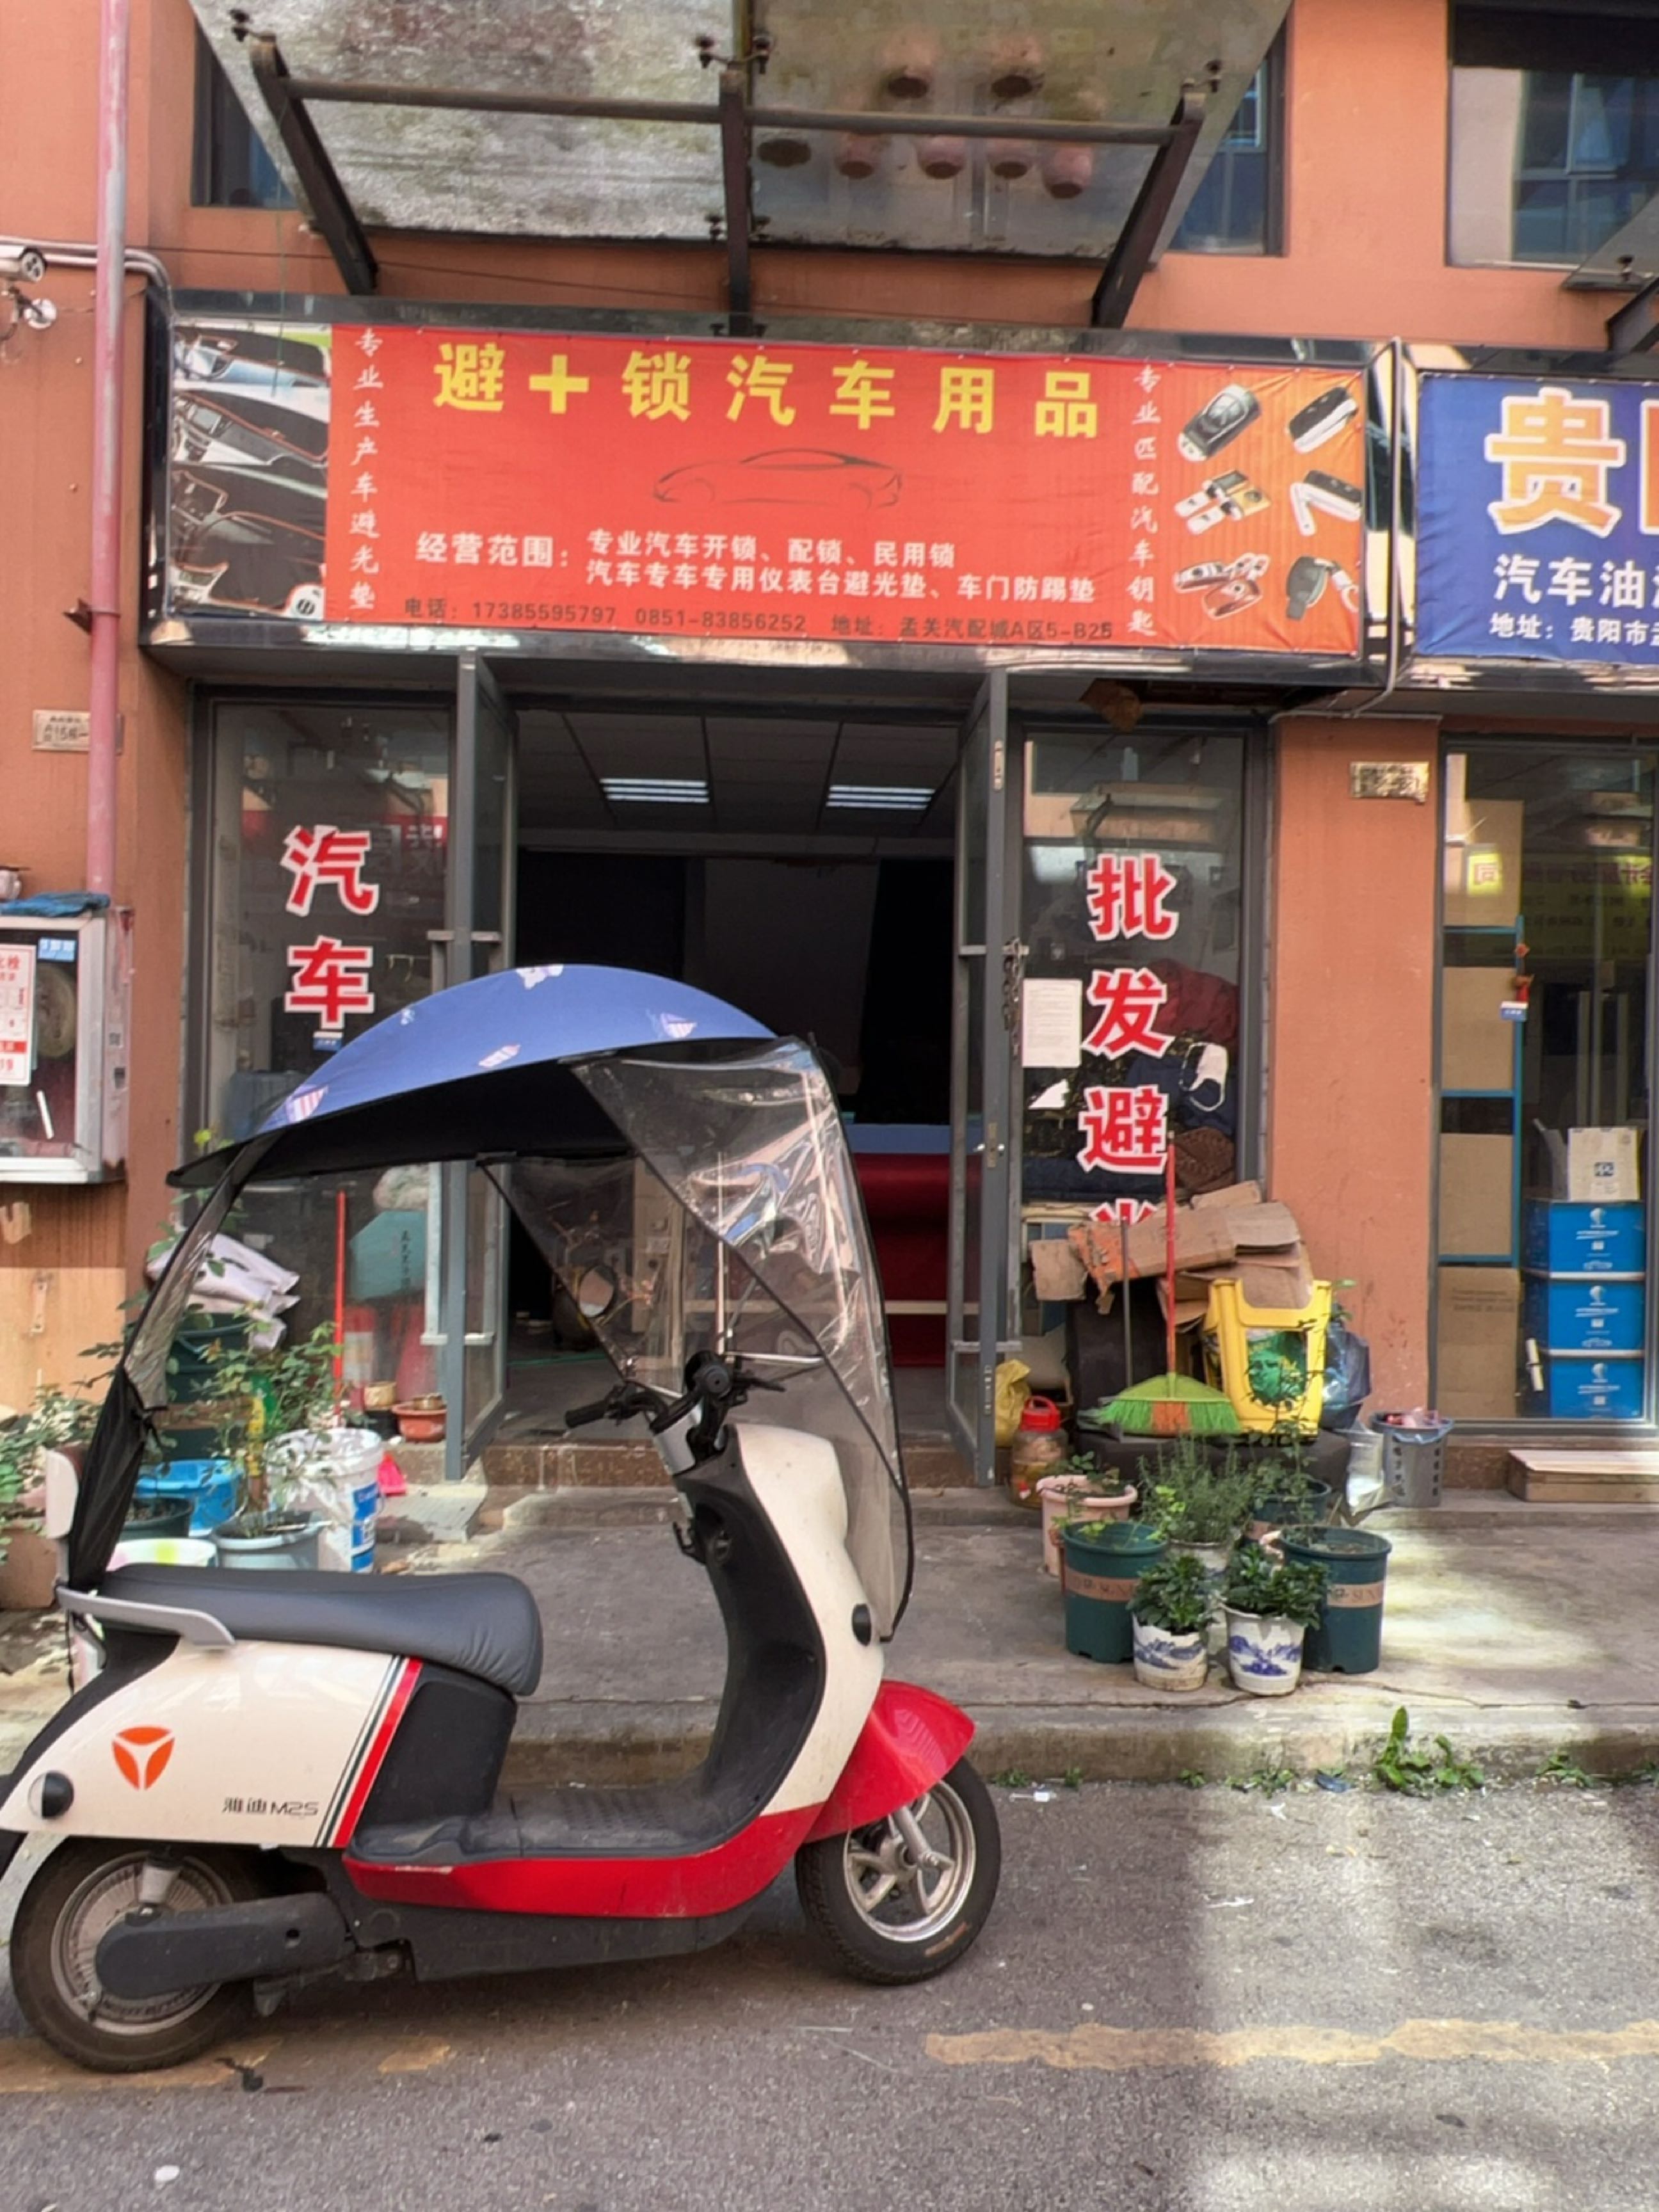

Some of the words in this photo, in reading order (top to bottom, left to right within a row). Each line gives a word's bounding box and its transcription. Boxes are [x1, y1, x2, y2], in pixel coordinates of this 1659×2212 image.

[349, 328, 383, 610] 专业生产车避光垫
[1126, 364, 1161, 636] 专业匹配汽车钥匙
[1484, 387, 1659, 538] 贵
[1493, 554, 1659, 609] 汽车油
[280, 824, 380, 1029] 汽车
